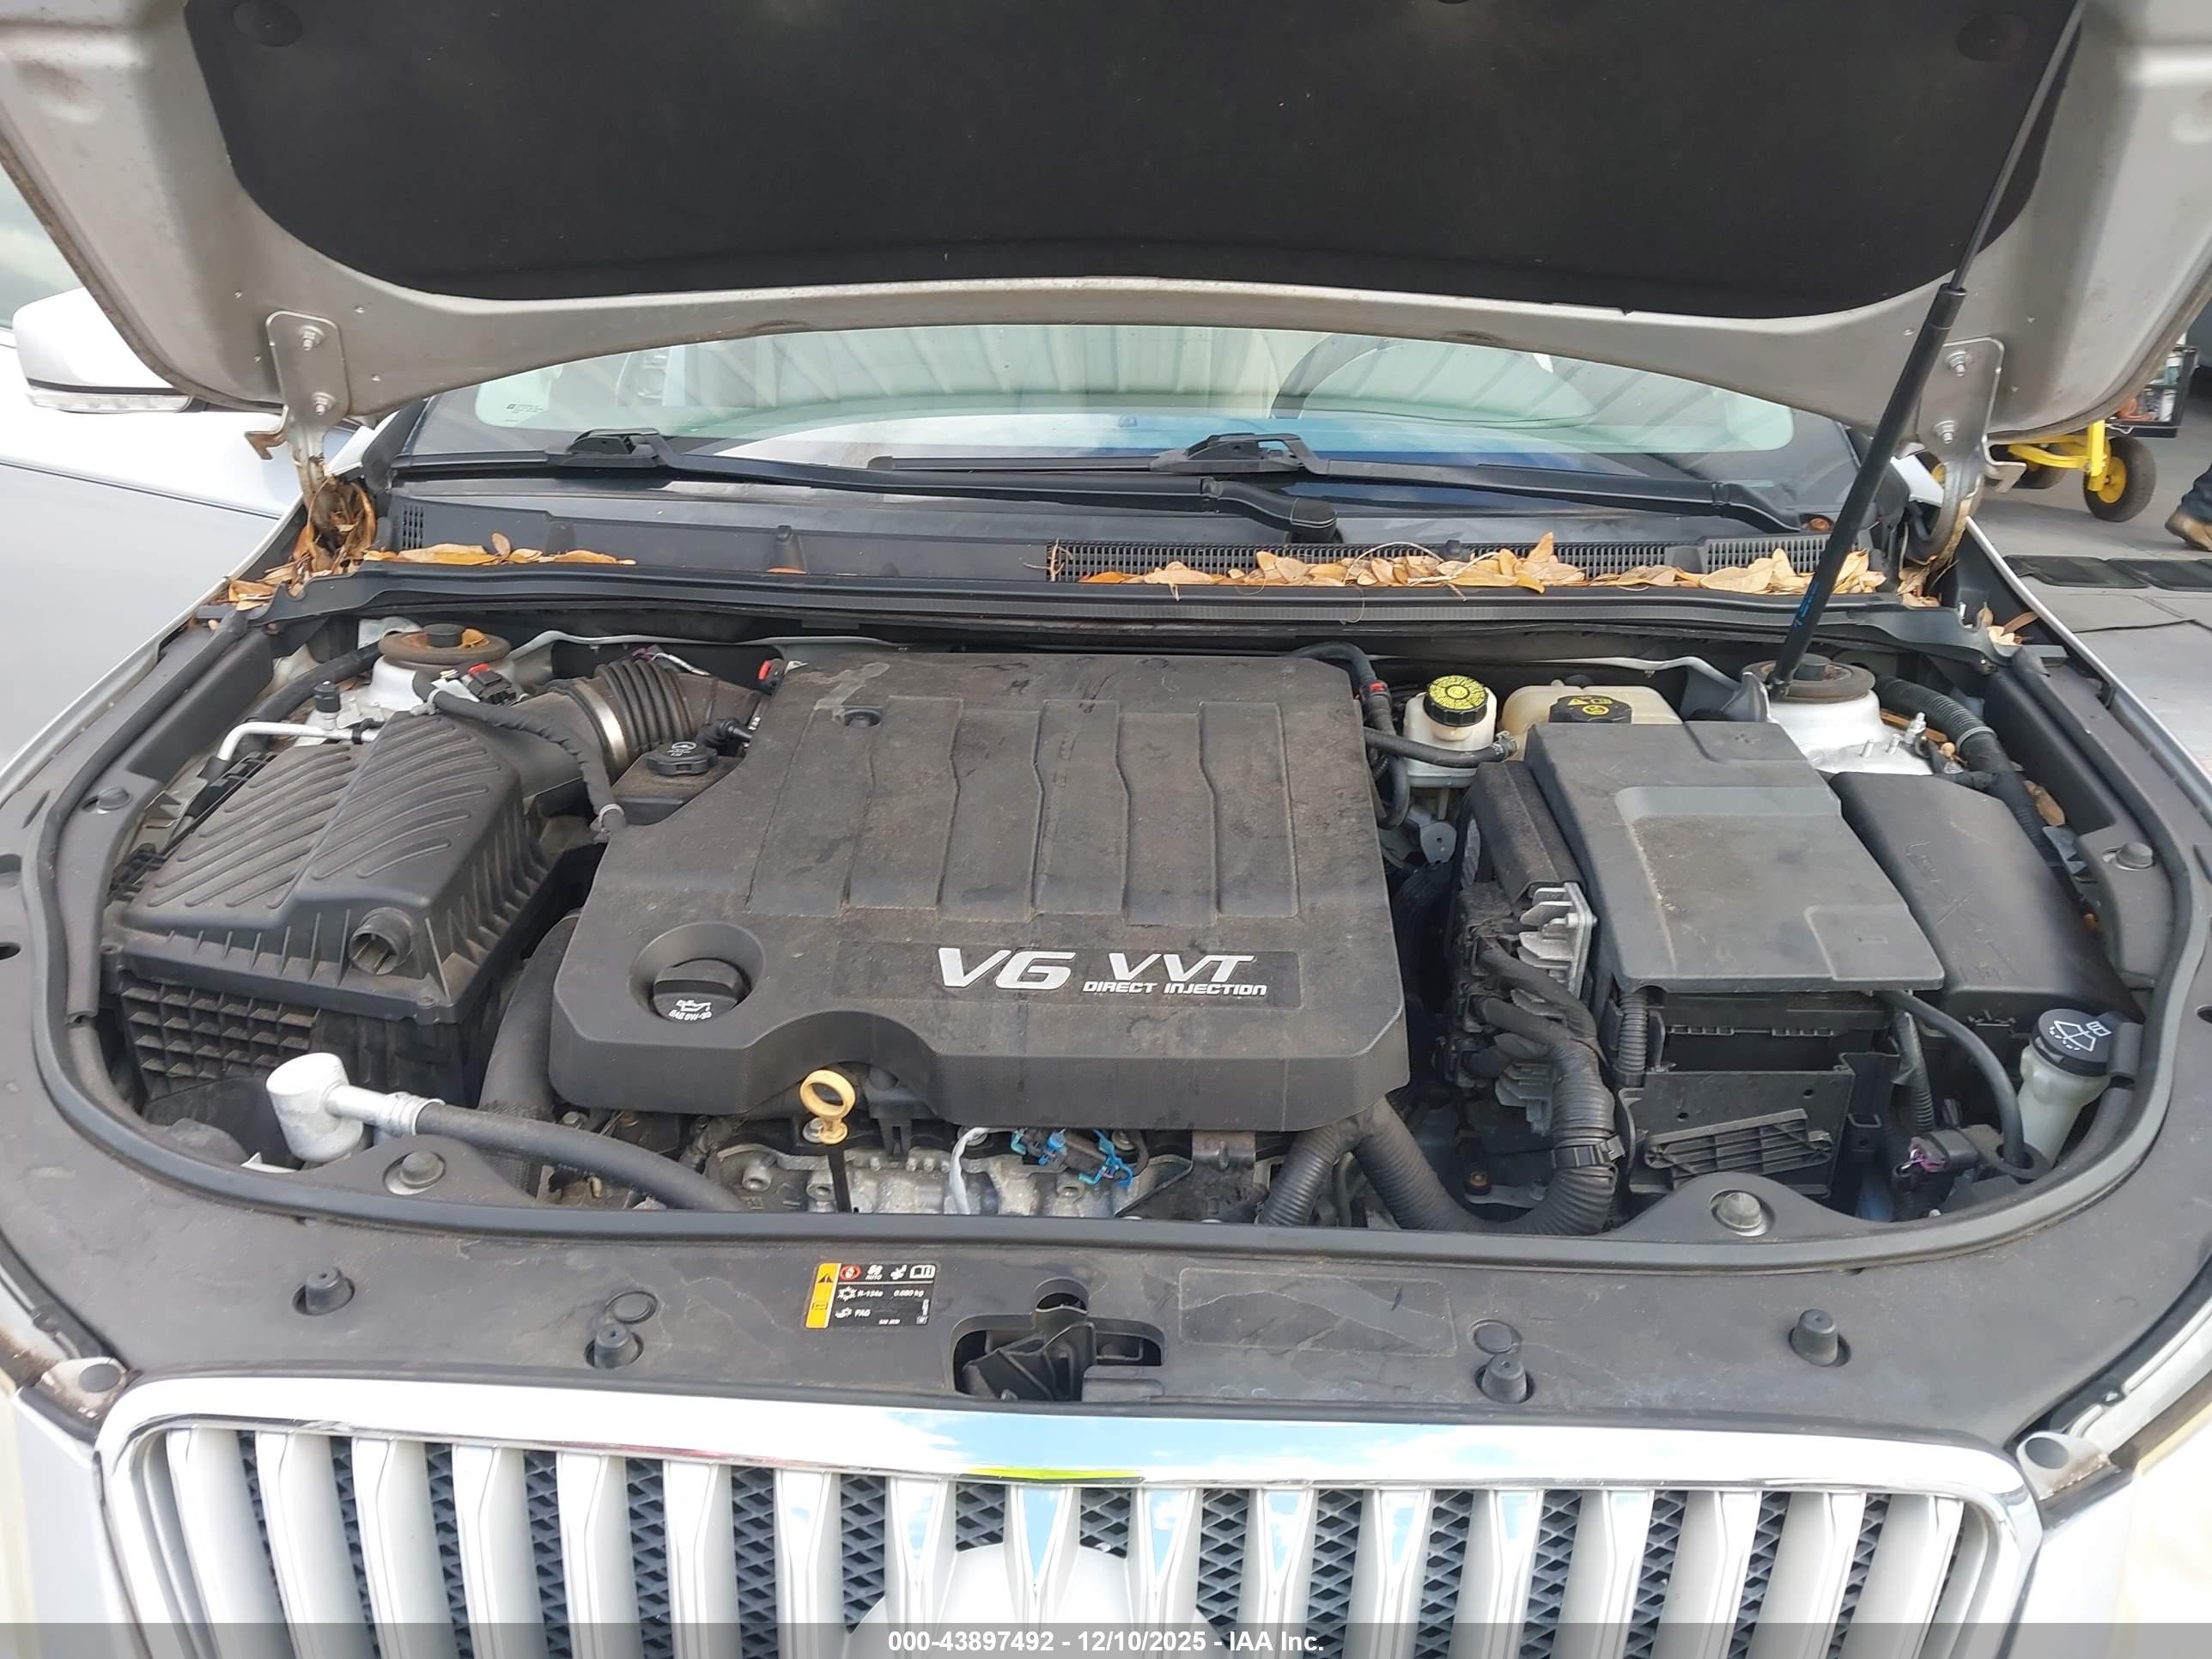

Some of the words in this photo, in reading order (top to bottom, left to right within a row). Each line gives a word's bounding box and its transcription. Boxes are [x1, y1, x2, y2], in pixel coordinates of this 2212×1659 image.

[939, 948, 1076, 990] V6
[1109, 952, 1255, 982] VVT
[1083, 981, 1157, 994] DIRECT
[1164, 982, 1267, 995] INJECTION
